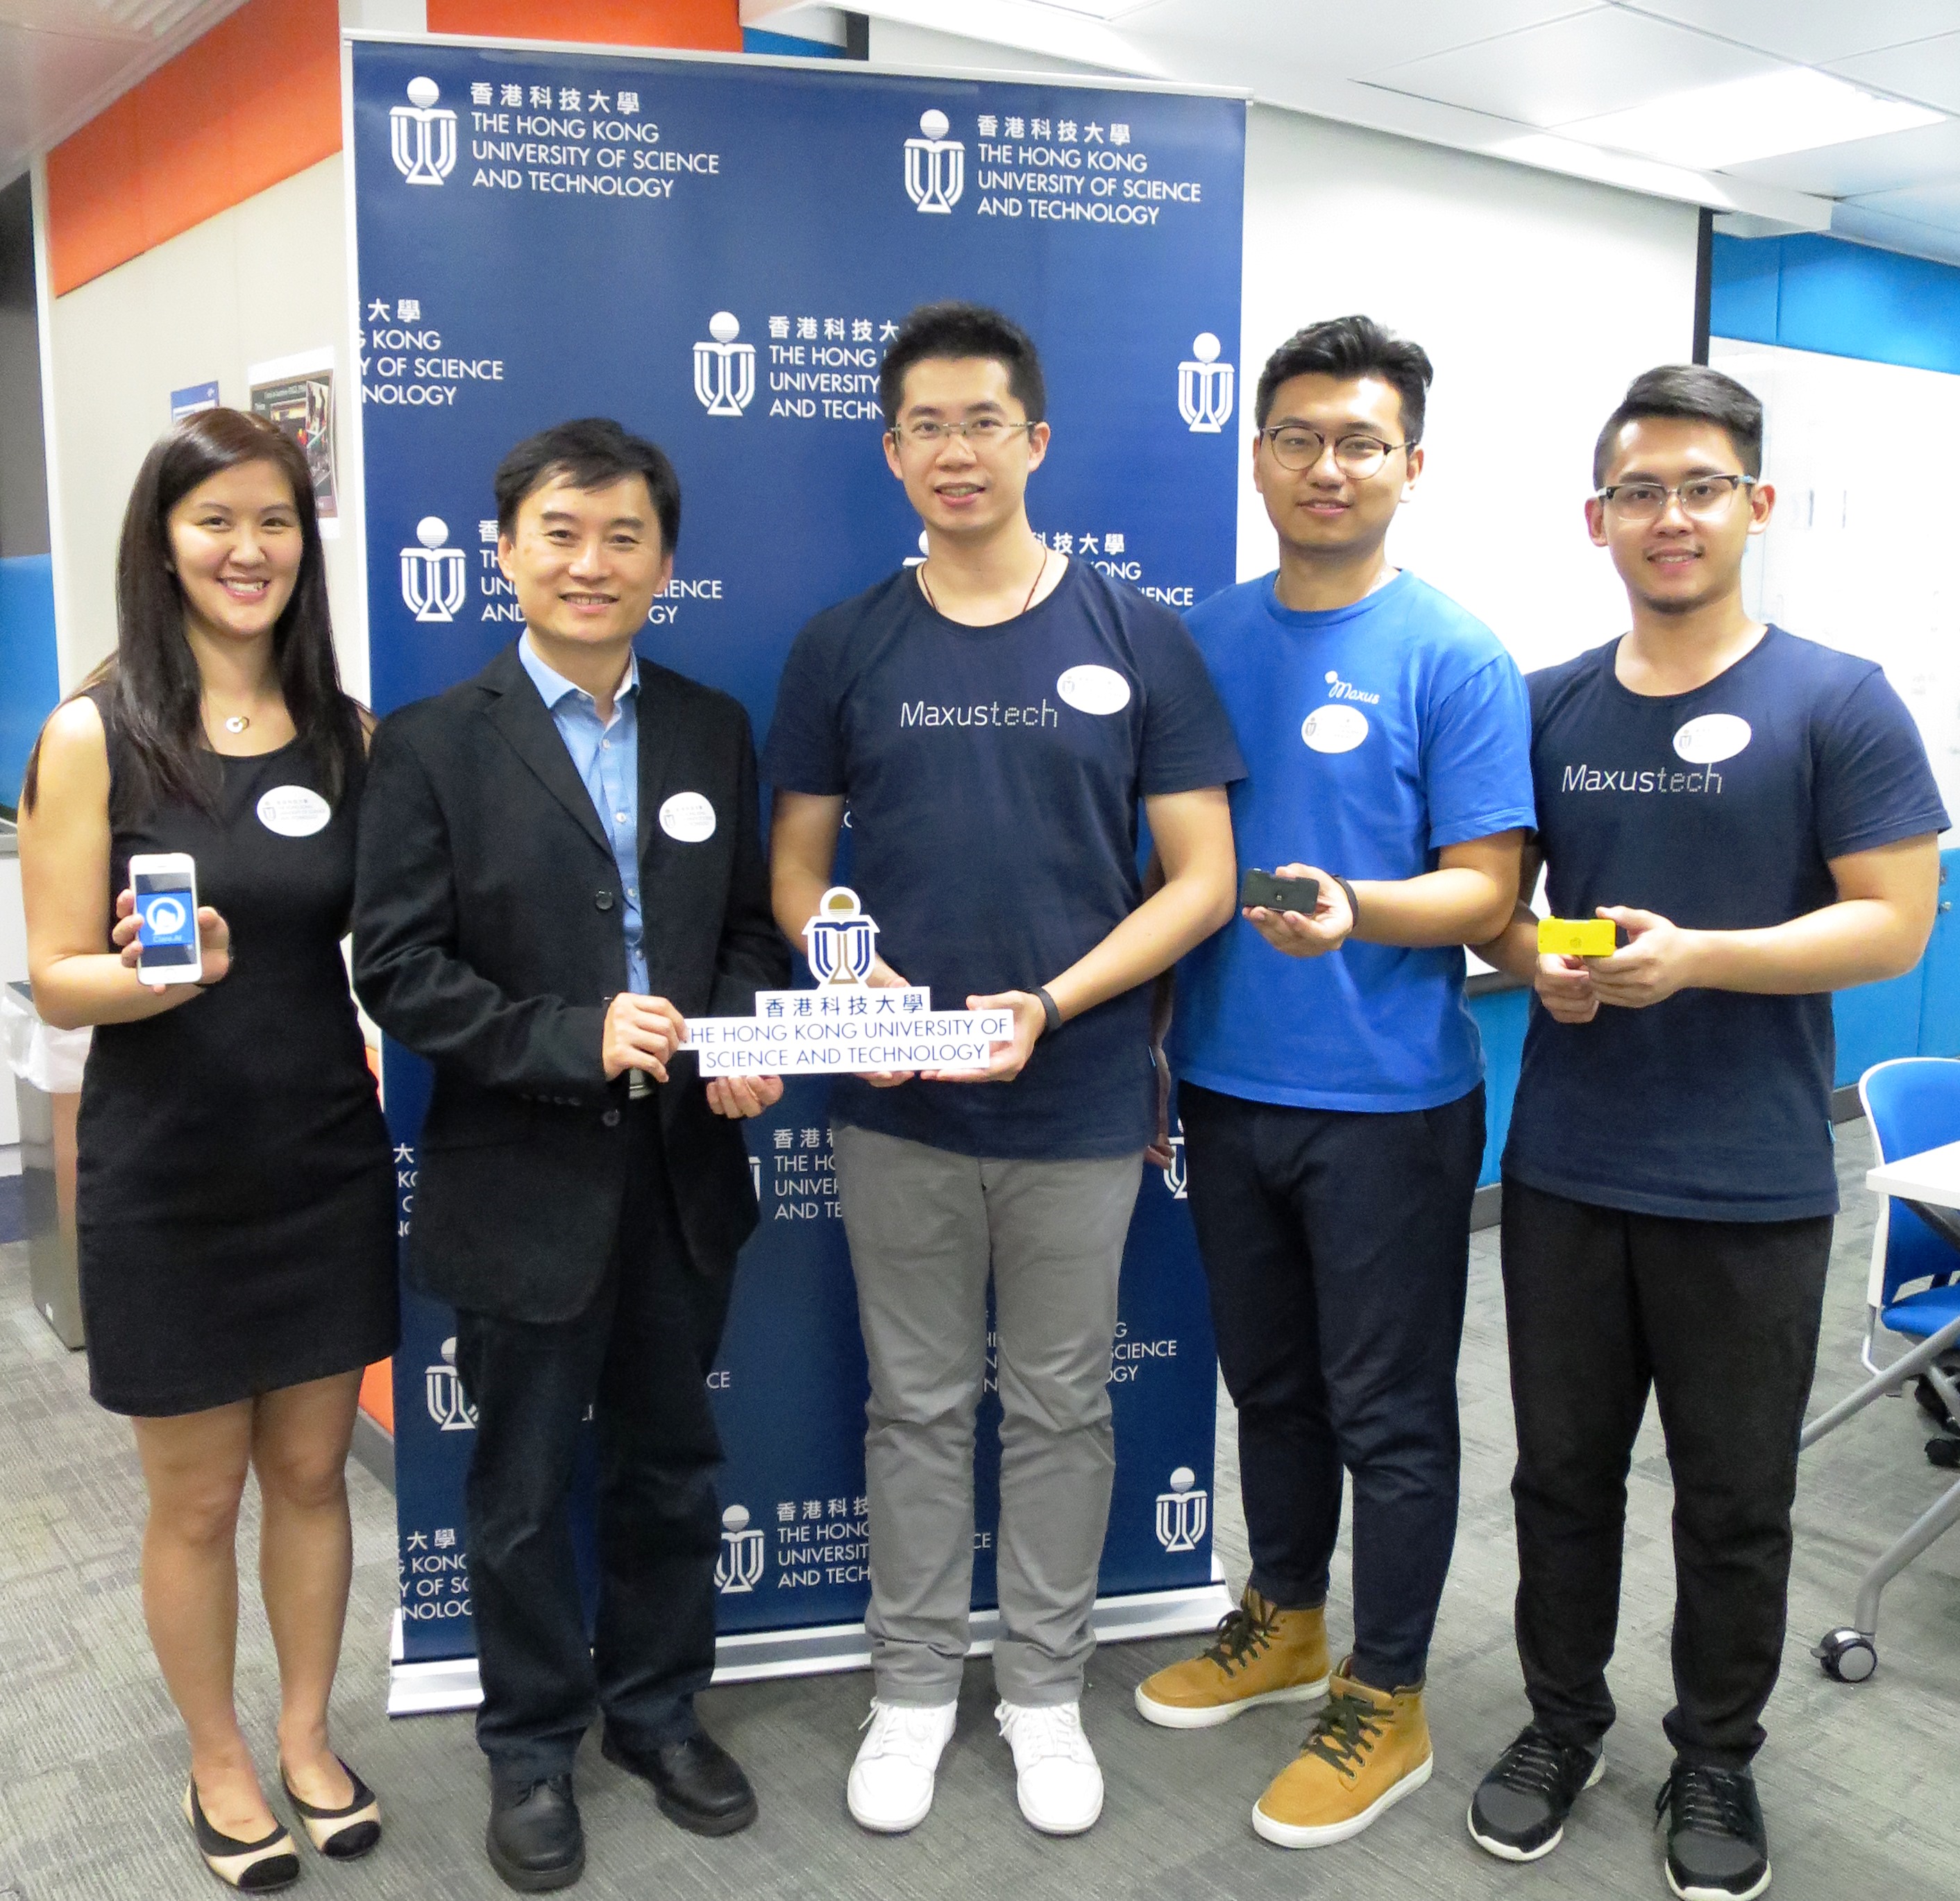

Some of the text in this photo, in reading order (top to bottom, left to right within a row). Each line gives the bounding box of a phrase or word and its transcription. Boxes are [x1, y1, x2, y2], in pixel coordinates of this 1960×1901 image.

[471, 83, 639, 115] 香港科技大學
[471, 112, 659, 143] THE HONG KONG
[977, 115, 1131, 146] 香港科技大學
[472, 140, 719, 174] UNIVERSITY OF SCIENCE
[978, 144, 1148, 173] THE HONG KONG
[473, 168, 674, 198] AND TECHNOLOGY
[979, 171, 1201, 203] UNIVERSITY OF SCIENCE
[978, 197, 1160, 225] AND TECHNOLOGY
[373, 329, 441, 350] KONG
[769, 345, 805, 365] THE
[812, 346, 877, 368] HONG
[377, 357, 407, 377] OF
[414, 357, 504, 380] SCIENCE
[770, 371, 881, 394] UNIVERSITY
[362, 384, 457, 405] NOLOGY
[769, 398, 816, 418] AND
[1328, 679, 1380, 704] Maxus
[900, 698, 1058, 728] Maxustech
[1562, 763, 1723, 794] Maxustech
[766, 994, 923, 1017] 香港科技大學
[689, 1018, 1008, 1043] HE HONG KONG UNIVERSITY OF
[707, 1044, 984, 1068] SCIENCE AND TECHNOLOGY
[773, 1128, 833, 1149] 香港
[774, 1155, 808, 1172] THE
[775, 1203, 818, 1220] AND
[1111, 1340, 1177, 1360] CIENCE
[777, 1526, 810, 1544] THE
[416, 1578, 444, 1596] OF
[778, 1566, 870, 1588] AND TECH
